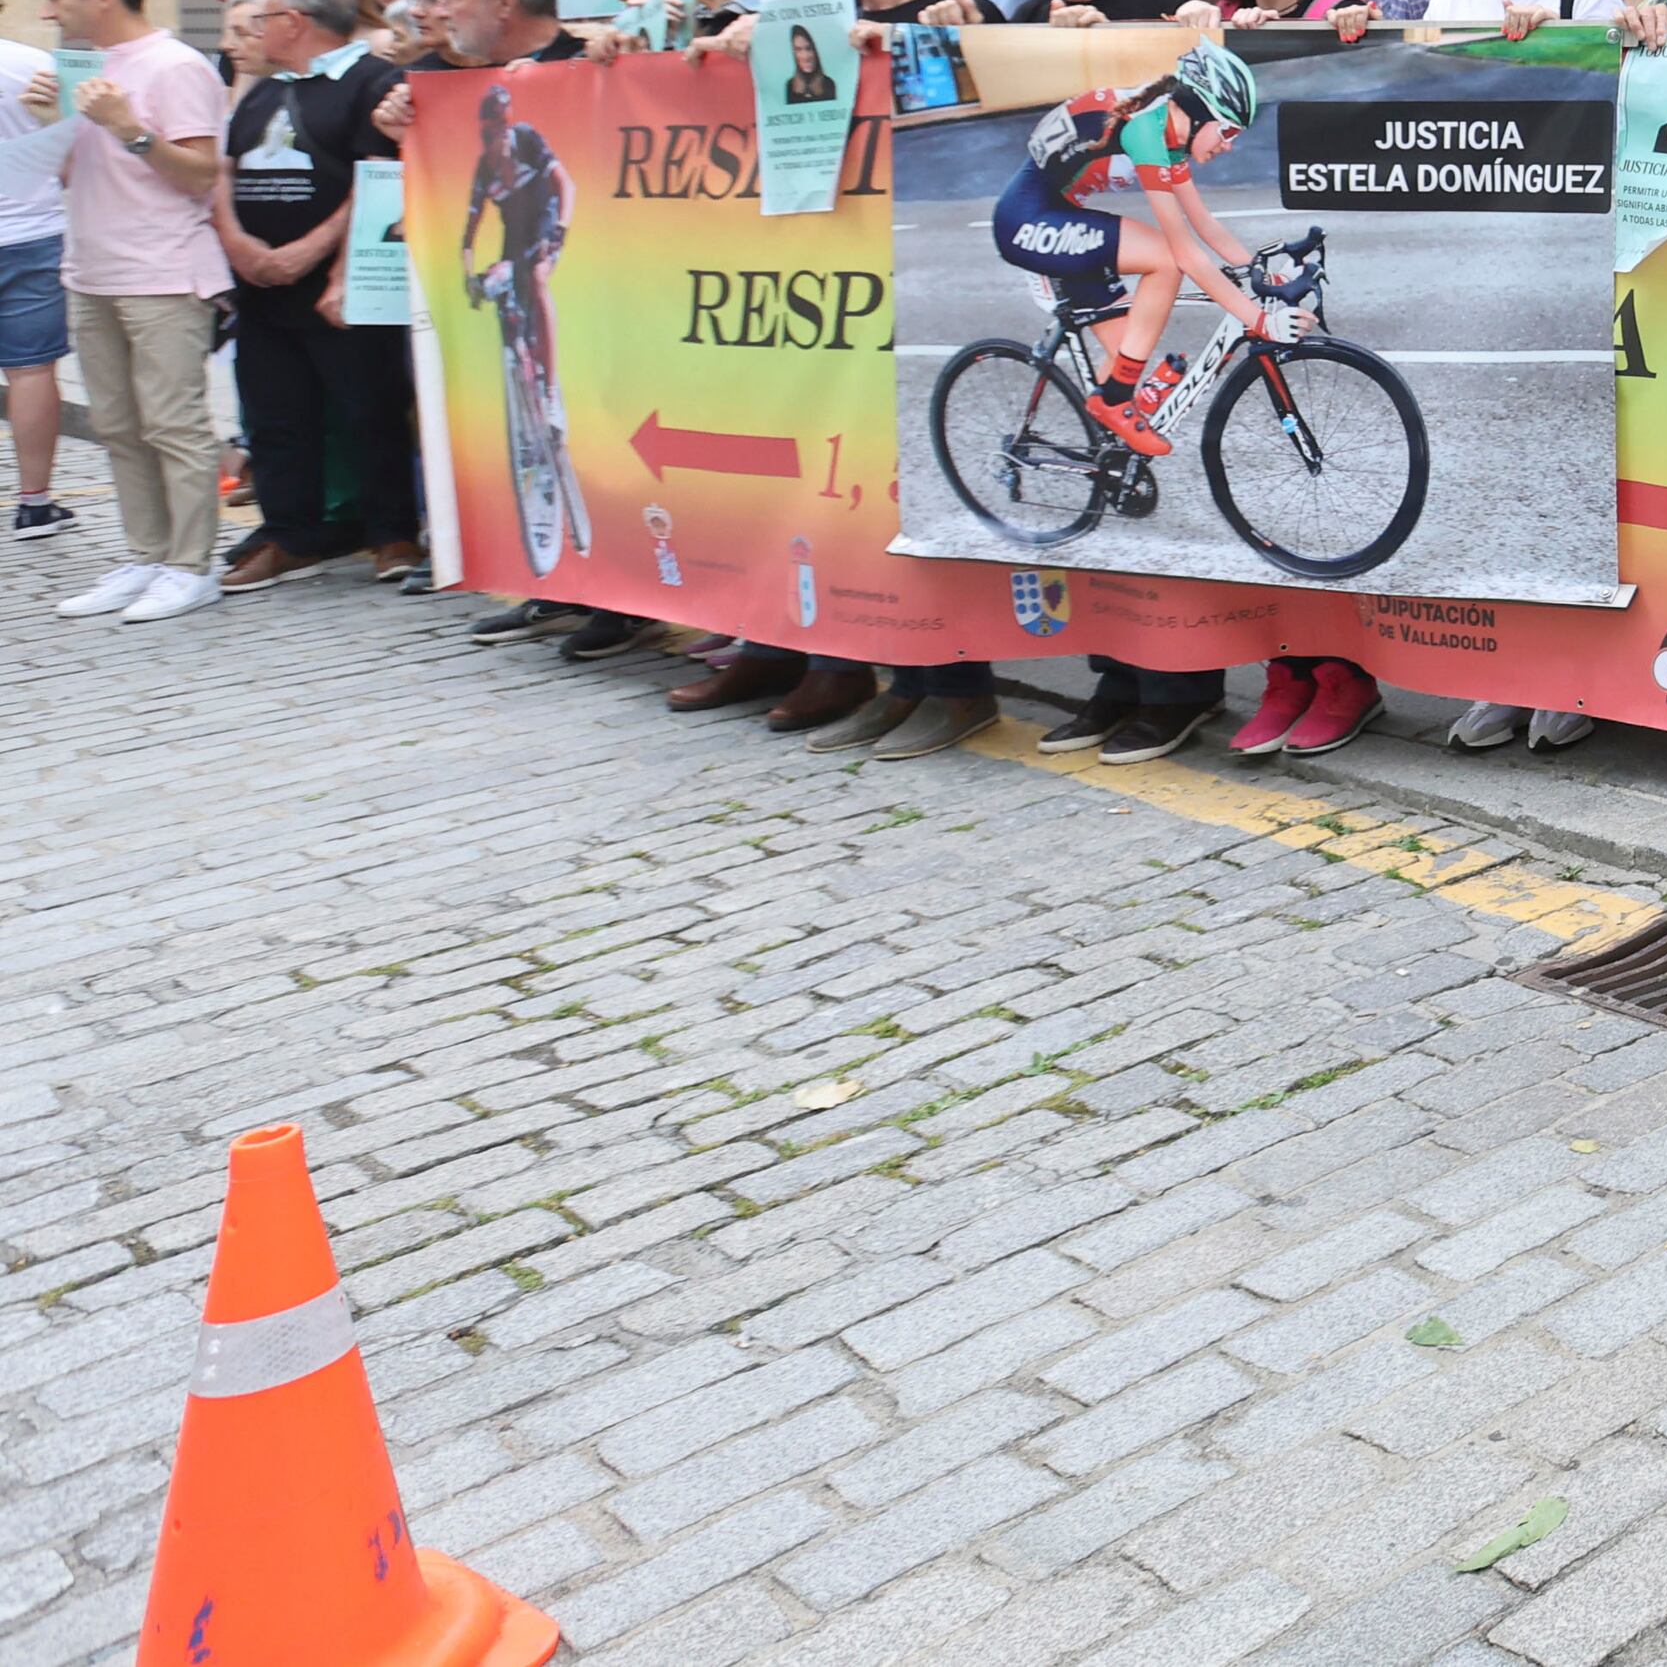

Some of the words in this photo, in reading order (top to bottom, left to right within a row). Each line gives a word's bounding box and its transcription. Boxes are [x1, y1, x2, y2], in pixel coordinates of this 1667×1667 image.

[1375, 121, 1524, 150] JUSTICIA
[1289, 164, 1409, 192] ESTELA
[1417, 158, 1605, 194] DOMÍNGUEZ
[1617, 199, 1653, 210] SIGNIFICA
[1623, 185, 1660, 197] PERMITIR
[1629, 215, 1653, 226] TODAS
[1376, 595, 1496, 628] DIPUTACIÓN
[1399, 624, 1497, 653] VALLADOLID
